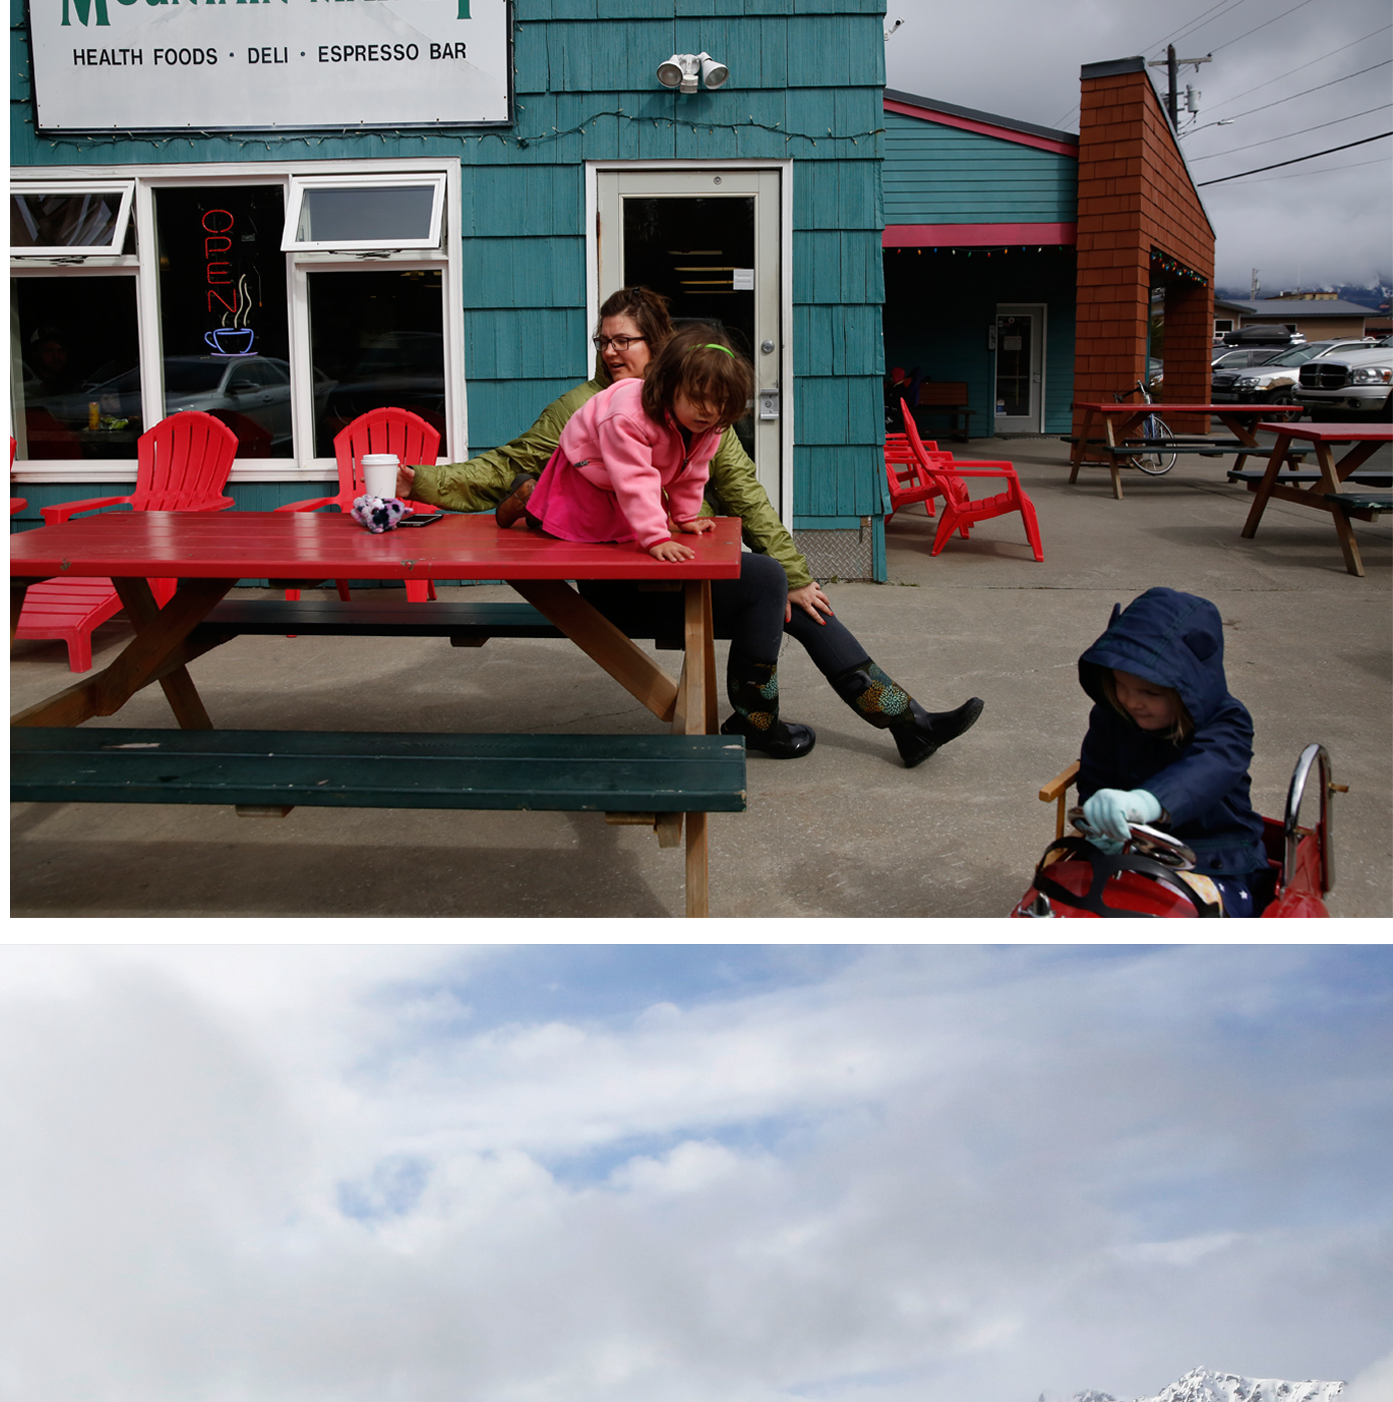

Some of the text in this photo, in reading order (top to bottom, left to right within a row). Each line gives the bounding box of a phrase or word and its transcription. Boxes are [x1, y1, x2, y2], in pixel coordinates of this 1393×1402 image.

[73, 42, 467, 66] HEALTH FOODS DELI ESPRESSO BAR
[202, 208, 237, 314] OPEN
